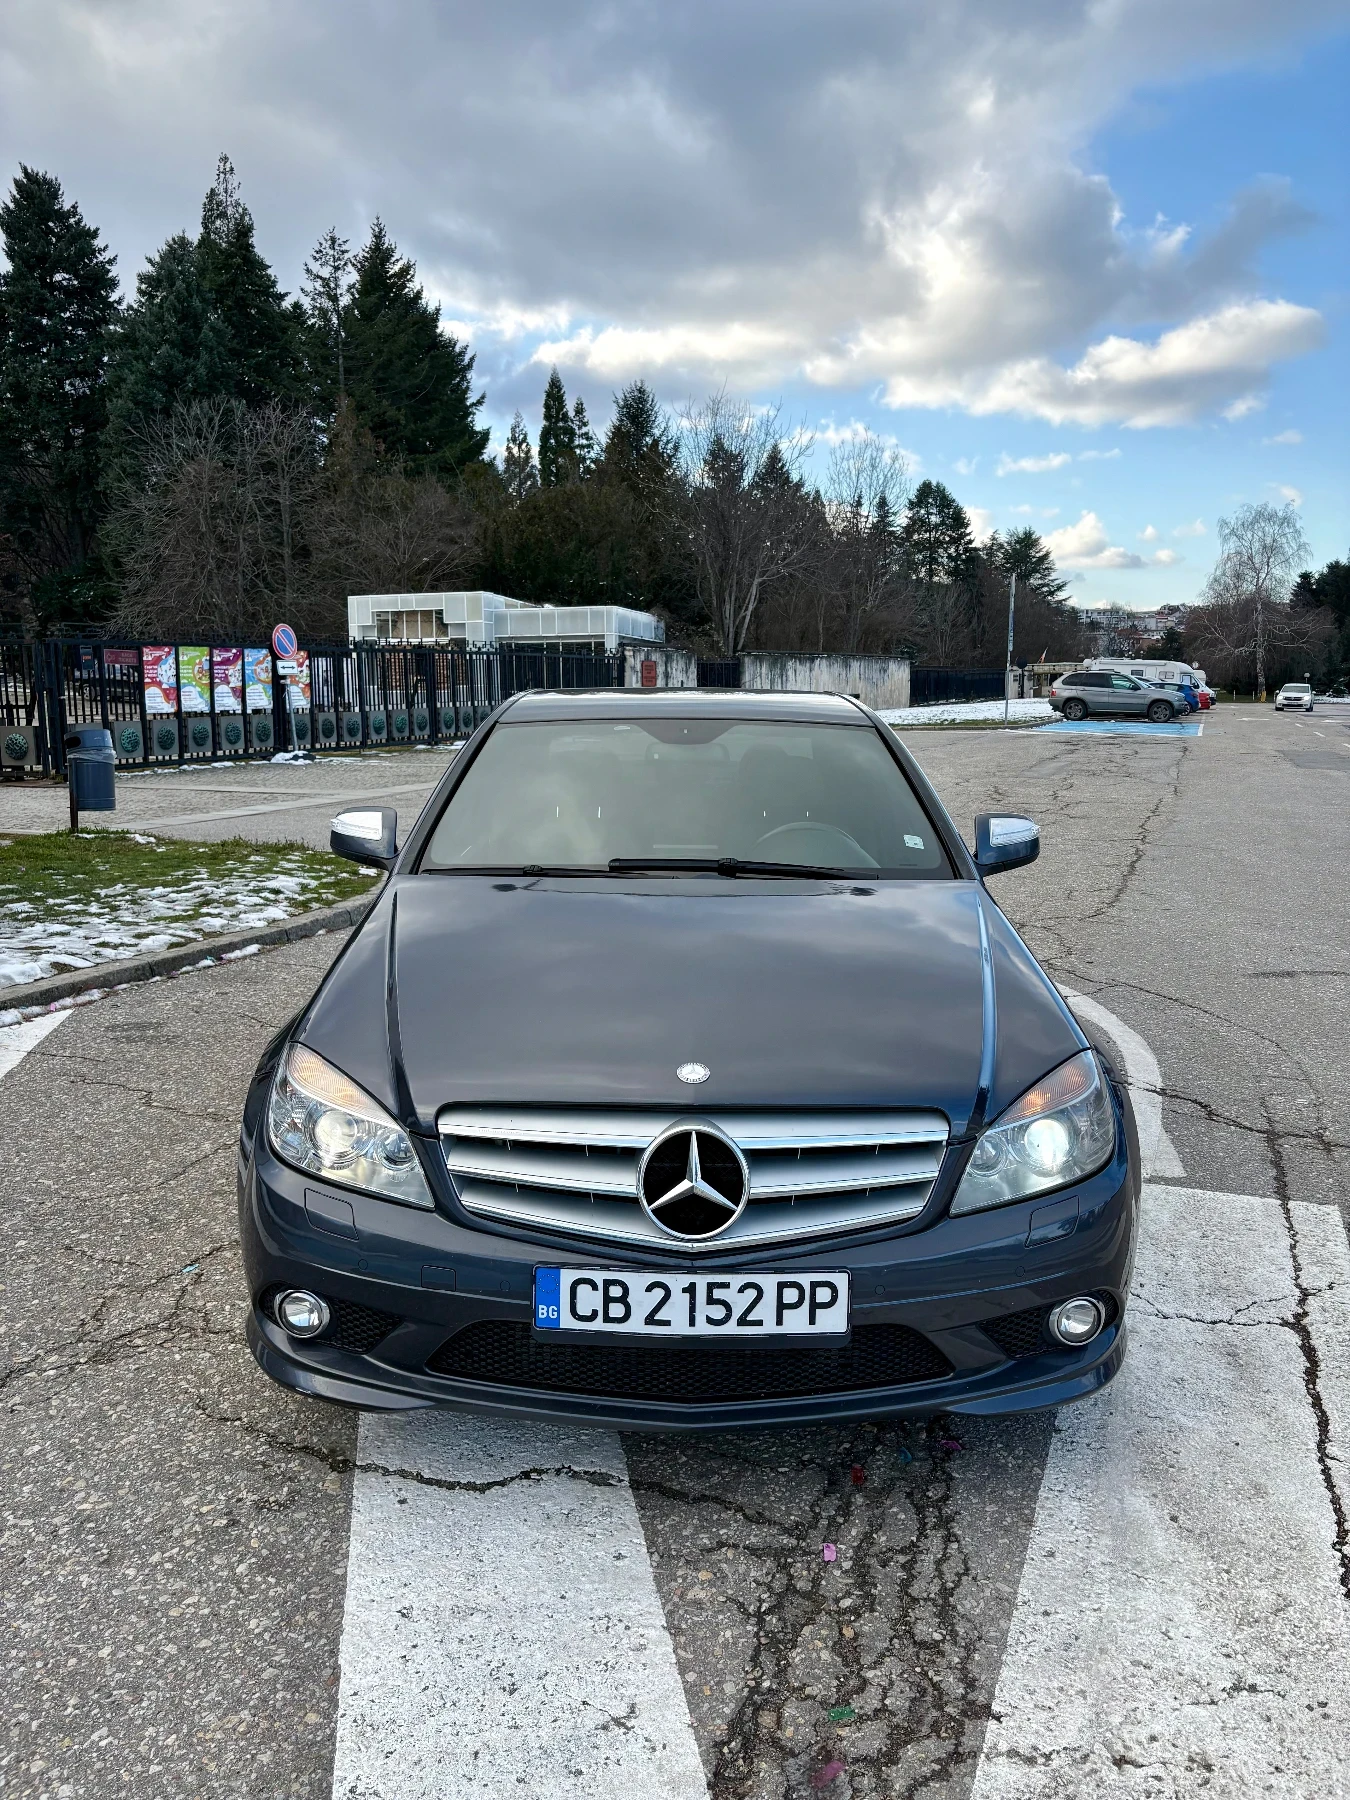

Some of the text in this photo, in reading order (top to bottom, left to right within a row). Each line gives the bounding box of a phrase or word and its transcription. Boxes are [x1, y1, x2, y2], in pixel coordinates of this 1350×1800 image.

[538, 1304, 558, 1319] BG
[569, 1277, 839, 1328] CB 2152 PP
